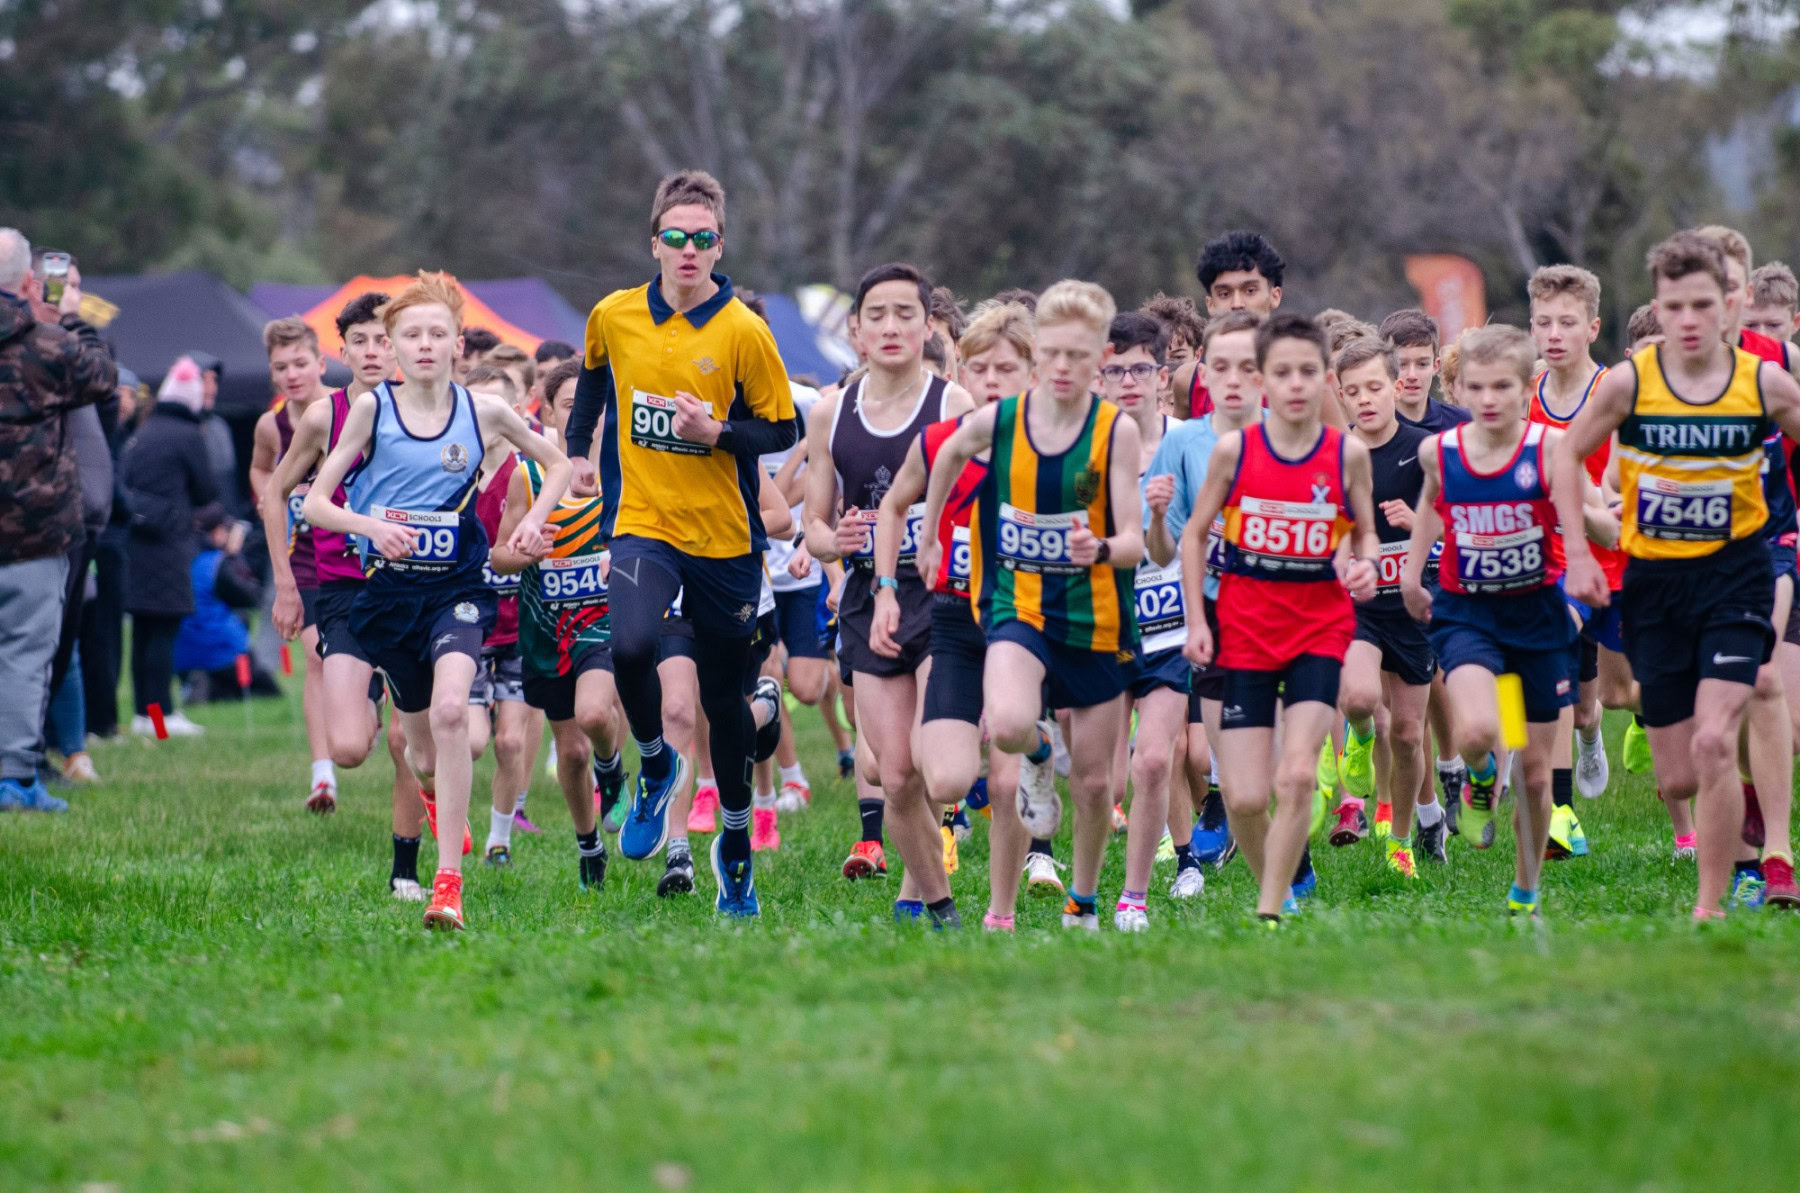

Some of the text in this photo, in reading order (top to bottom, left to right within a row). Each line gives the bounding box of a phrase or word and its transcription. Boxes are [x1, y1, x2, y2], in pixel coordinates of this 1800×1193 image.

[1640, 423, 1757, 450] TRINITY
[409, 514, 442, 523] SCHOOLS
[1450, 503, 1533, 534] SMGS
[1640, 491, 1729, 528] 7546
[1243, 515, 1330, 555] 8516
[1459, 542, 1543, 578] 7538
